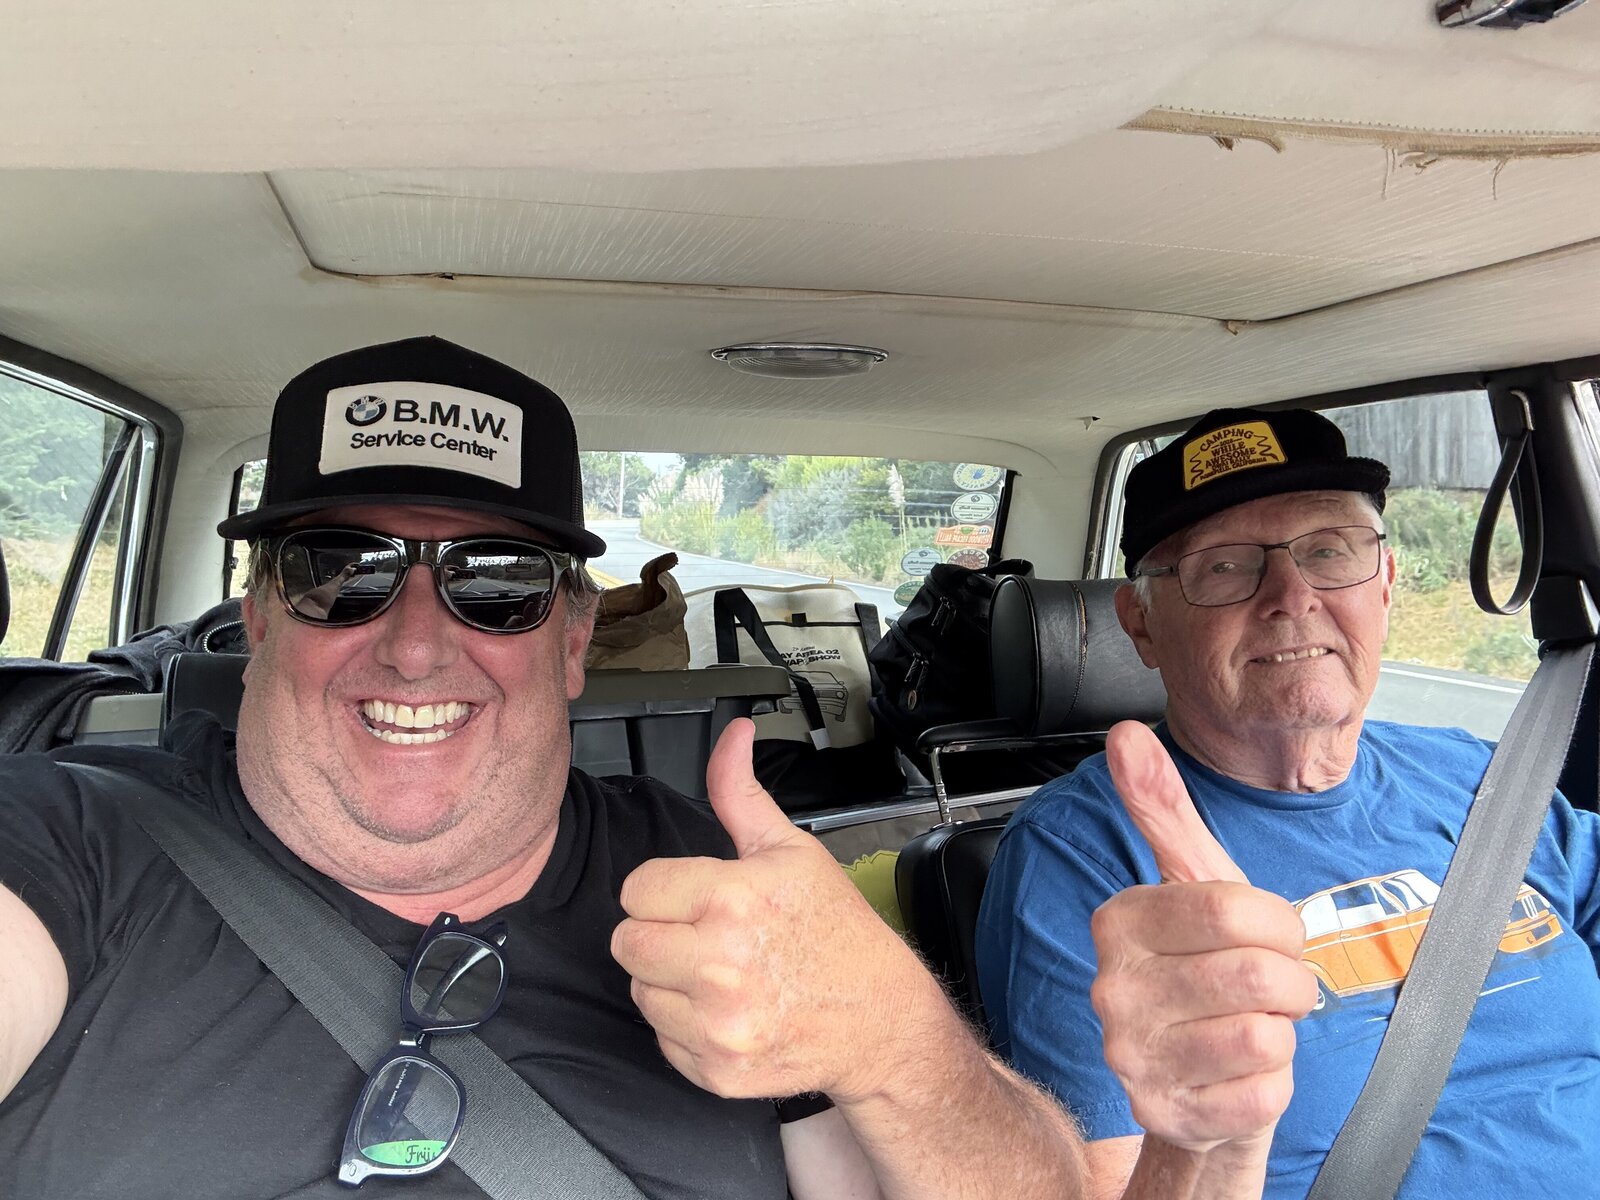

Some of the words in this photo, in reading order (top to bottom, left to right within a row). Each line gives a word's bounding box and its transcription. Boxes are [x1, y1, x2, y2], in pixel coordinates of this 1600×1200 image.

[393, 399, 509, 442] B.M.W.
[351, 430, 425, 449] Service
[430, 432, 497, 461] Center
[1200, 428, 1254, 452] CAMPING
[1211, 441, 1246, 456] WHILE
[1205, 447, 1257, 469] AWESOME
[796, 650, 824, 658] AREA
